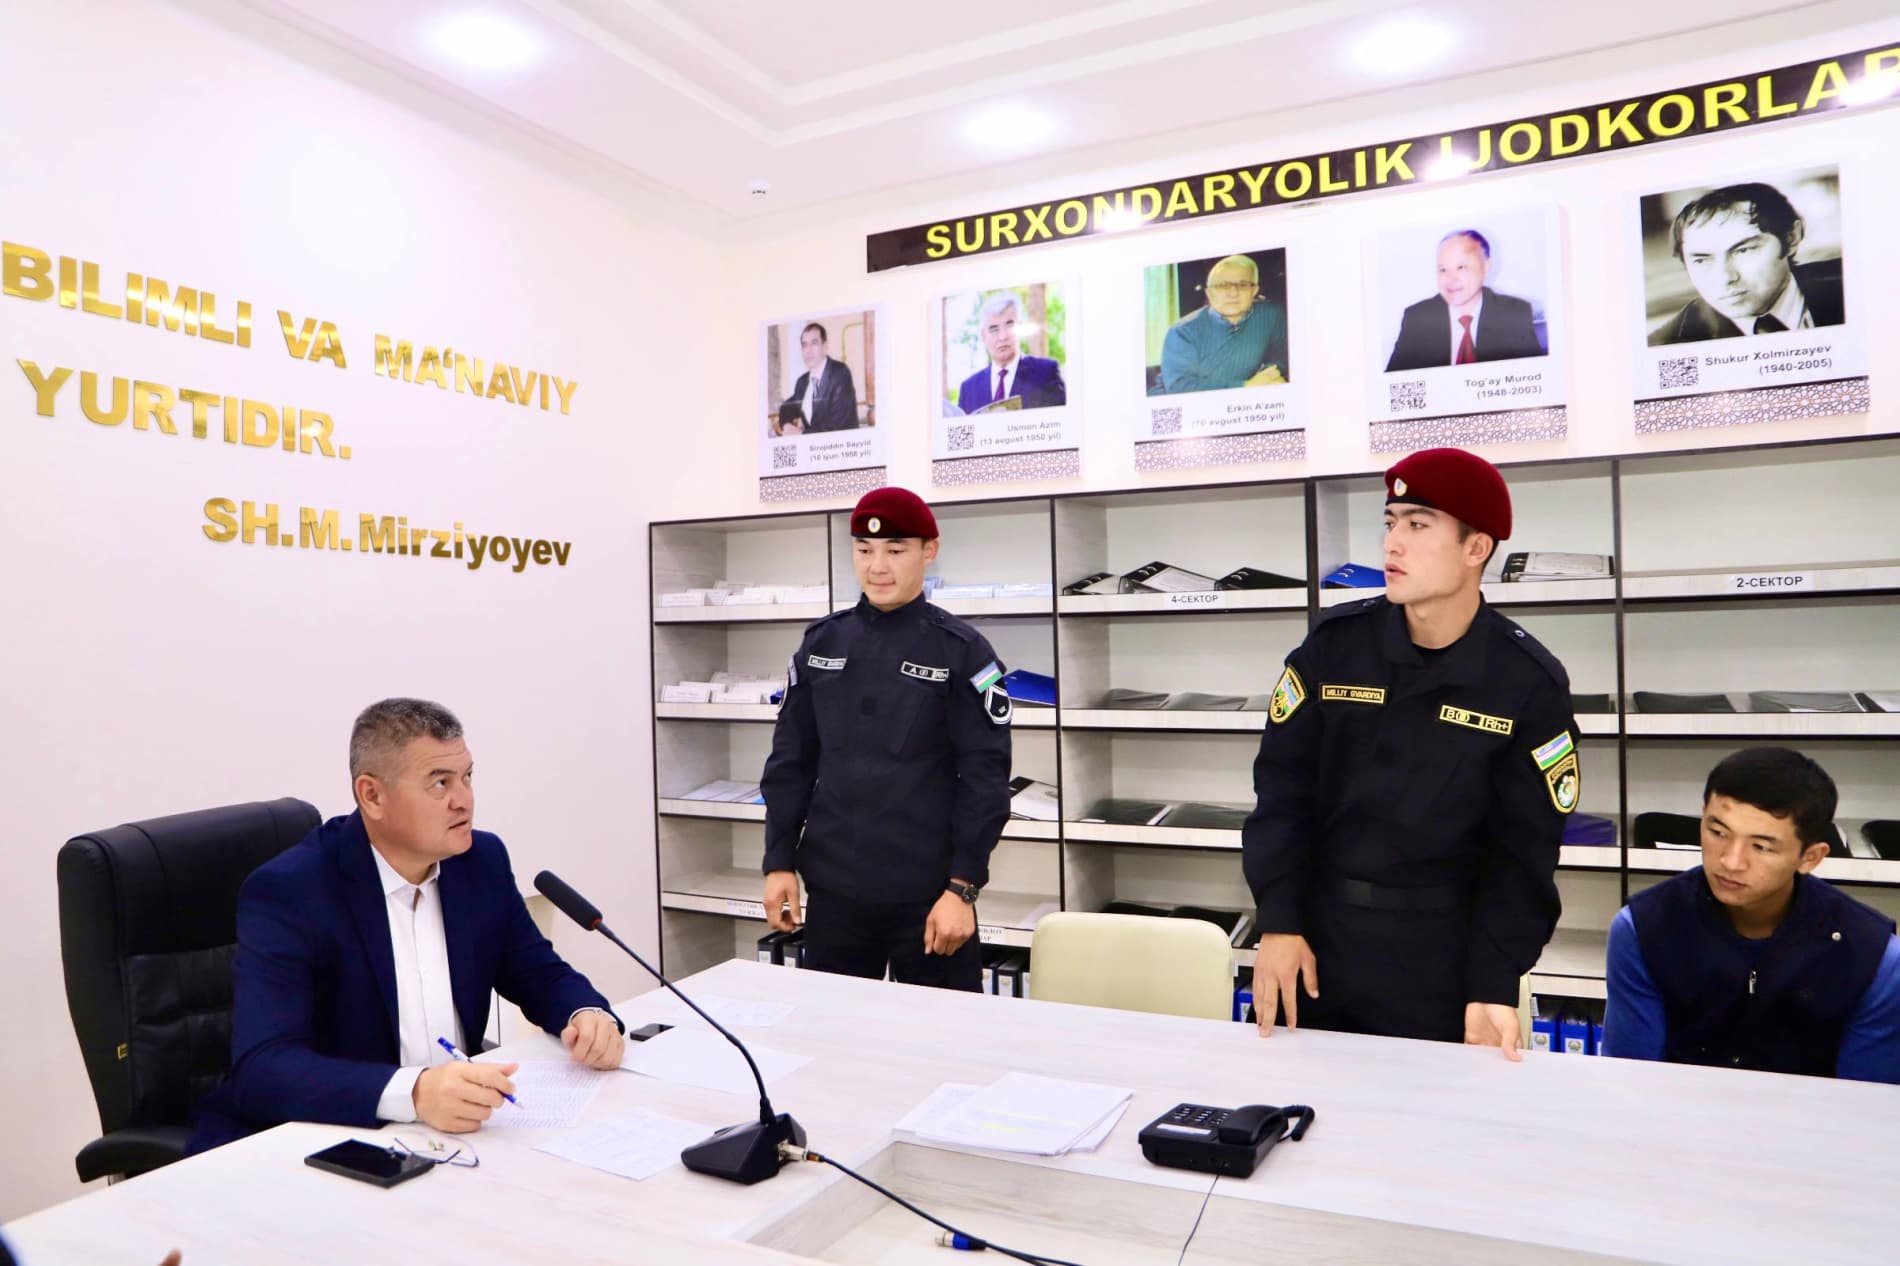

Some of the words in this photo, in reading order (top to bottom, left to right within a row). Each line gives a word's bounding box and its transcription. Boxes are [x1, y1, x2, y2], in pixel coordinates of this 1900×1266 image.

[925, 142, 1416, 259] SURXONDARYOLIK
[1, 240, 252, 348] BILIMLI
[276, 308, 348, 369] VA
[1705, 354, 1749, 366] Shukur
[1753, 345, 1832, 361] Xolmirzayev
[1759, 358, 1833, 375] (1940-2005)
[1505, 373, 1542, 384] Murod
[16, 358, 352, 460] YURTIDIR.
[1736, 576, 1804, 588] 2-СЕКТОР
[1171, 594, 1219, 604] 4-СЕКТОР
